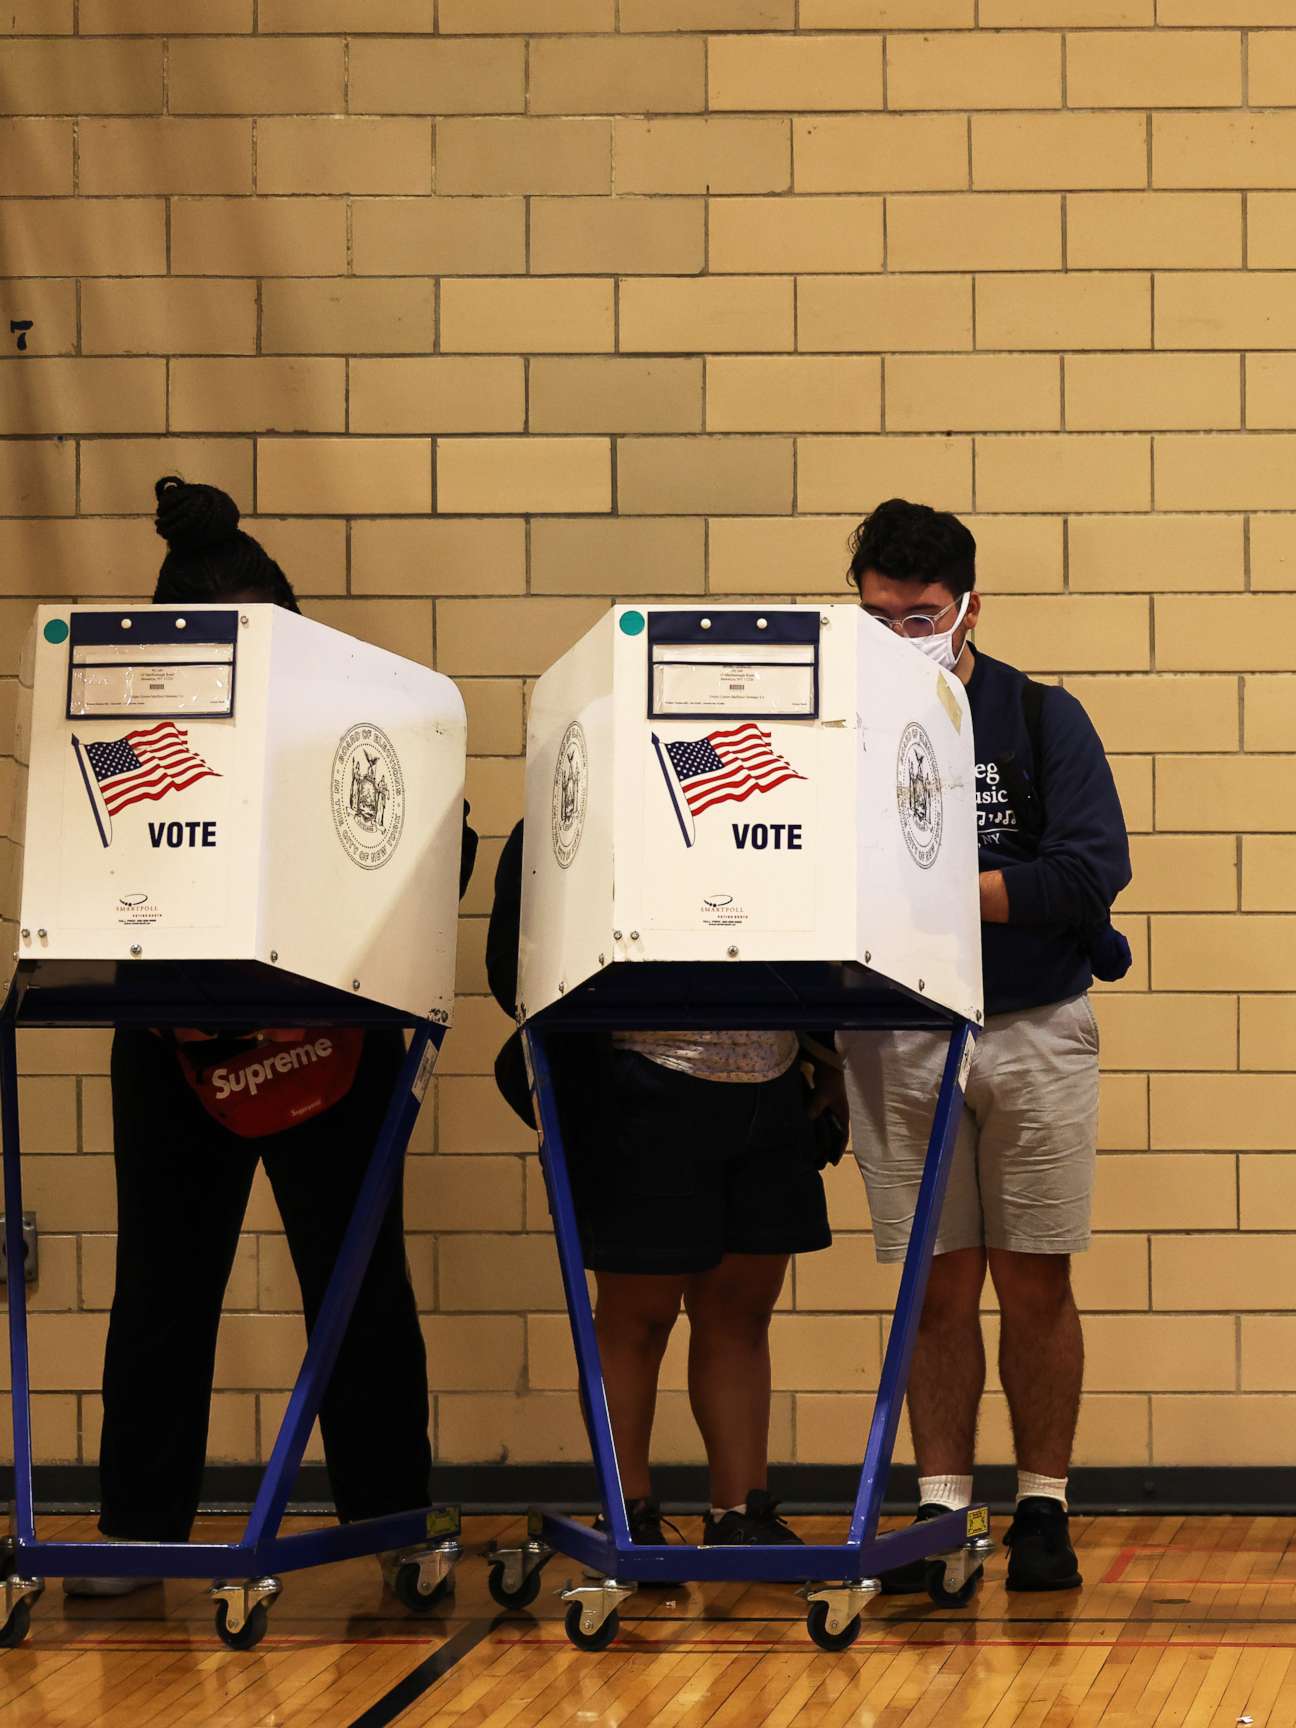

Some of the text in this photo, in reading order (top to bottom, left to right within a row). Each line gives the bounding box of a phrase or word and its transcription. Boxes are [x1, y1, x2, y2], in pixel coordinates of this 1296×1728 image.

[975, 763, 1000, 785] eg
[976, 786, 1008, 804] usic
[148, 821, 217, 848] VOTE
[732, 823, 802, 850] VOTE
[982, 833, 1000, 846] NY
[212, 1038, 333, 1099] Supreme
